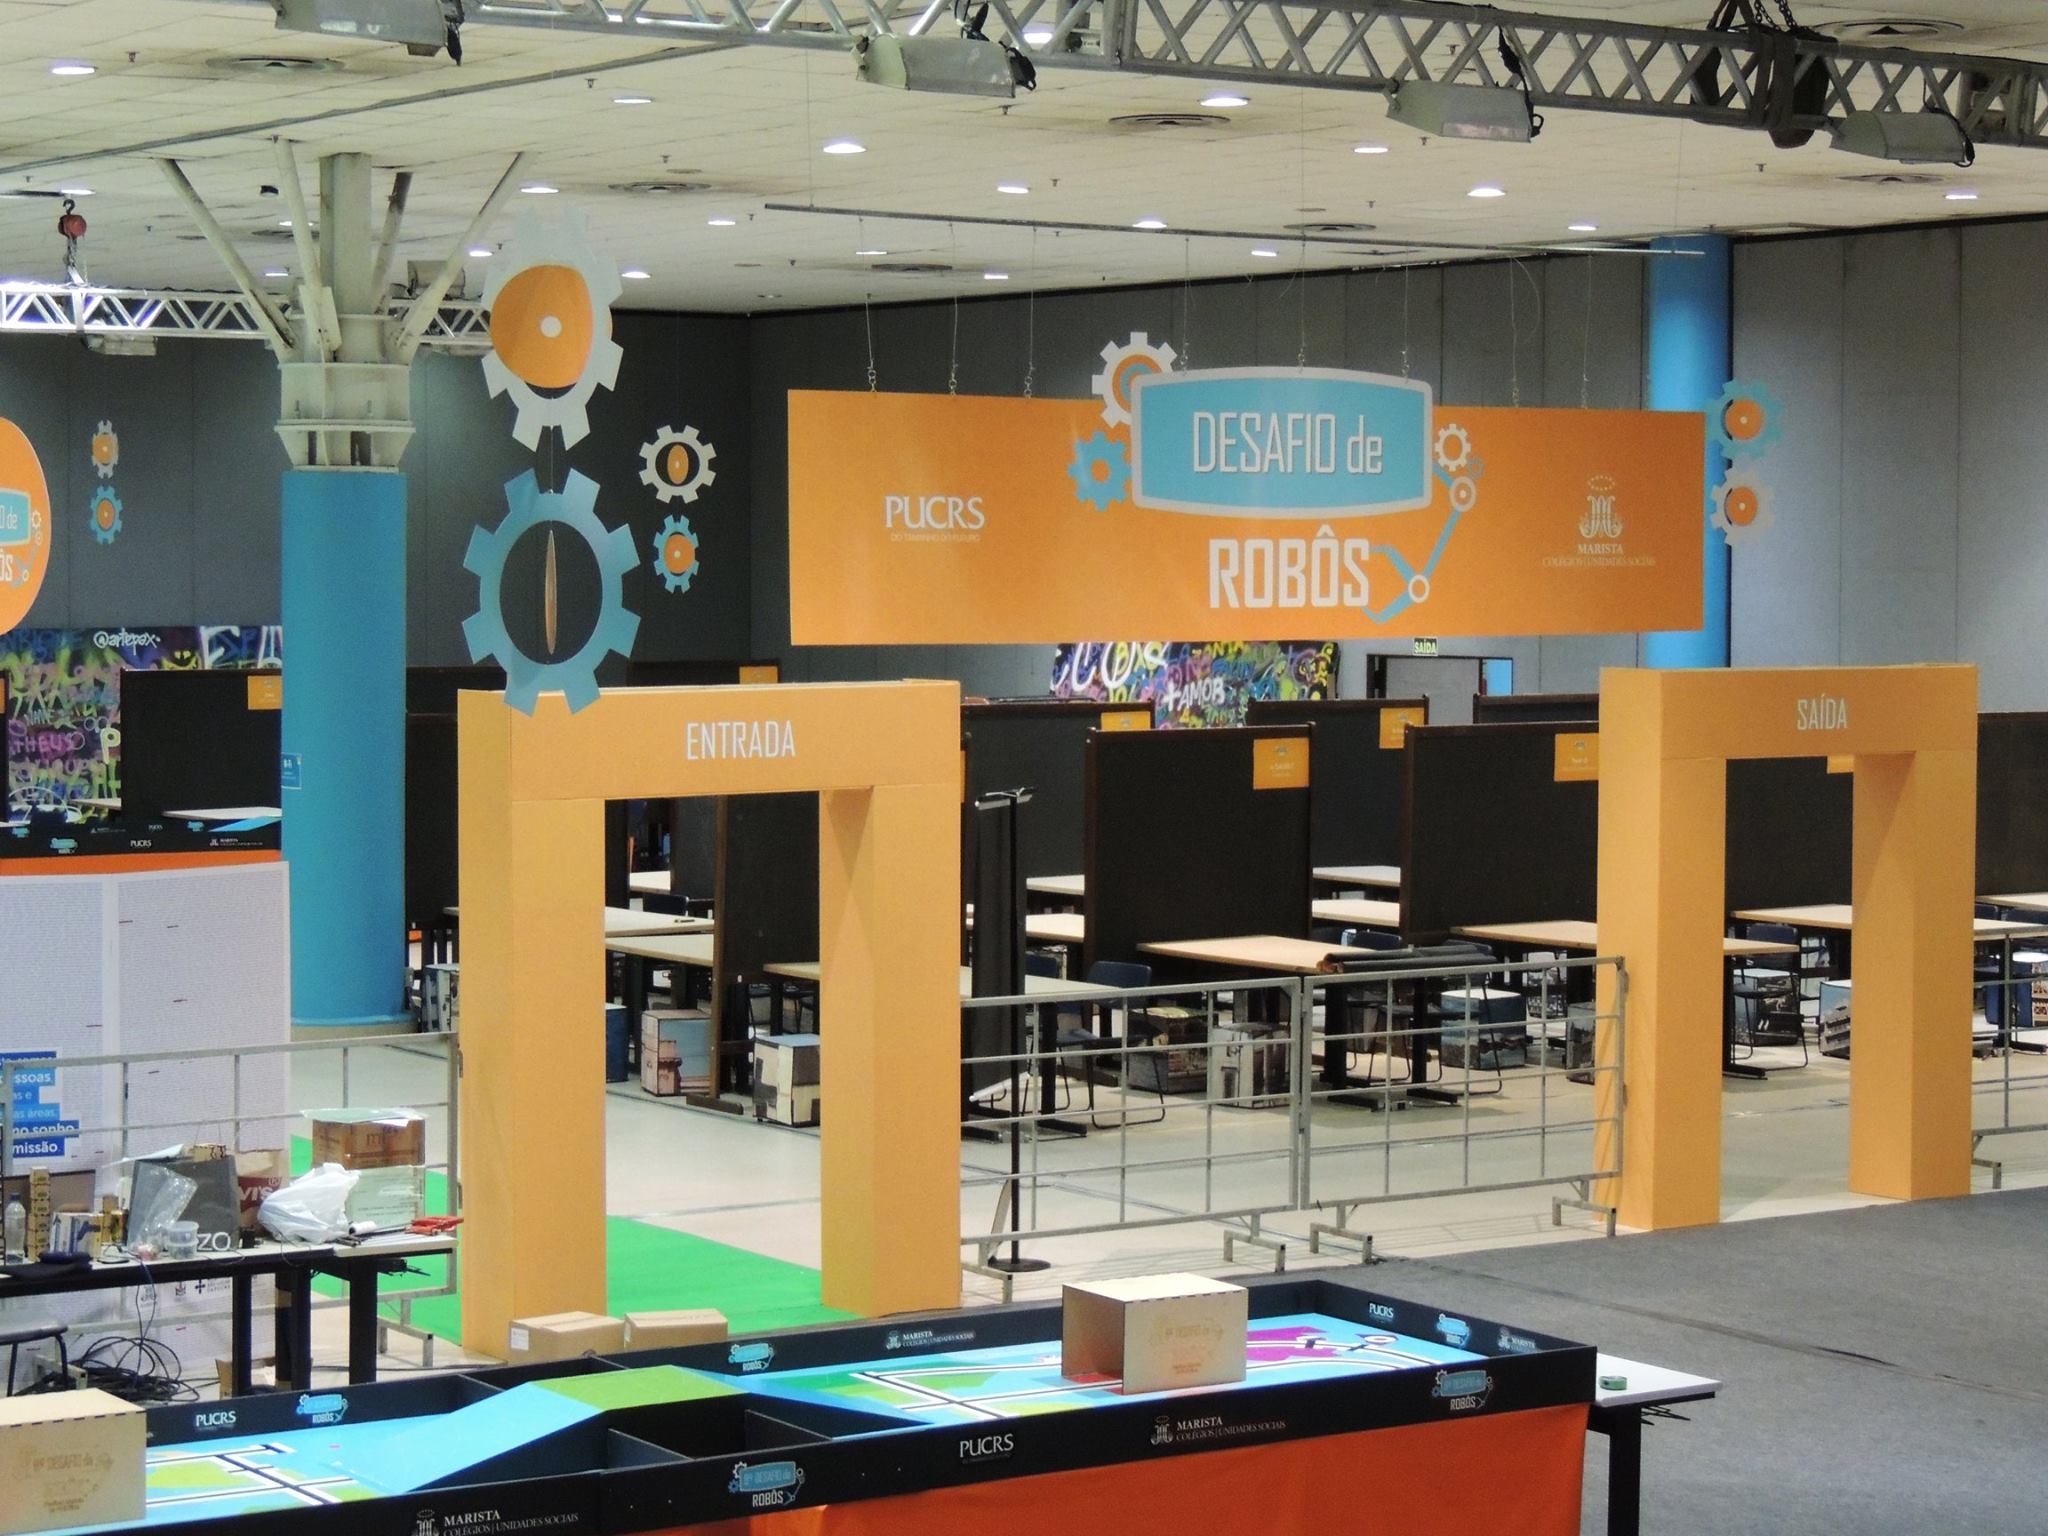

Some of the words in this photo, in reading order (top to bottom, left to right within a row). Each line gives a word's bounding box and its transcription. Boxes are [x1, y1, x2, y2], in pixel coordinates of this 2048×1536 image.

[1193, 412, 1336, 473] DESAFIO
[1346, 414, 1383, 474] de
[885, 495, 985, 529] PUCRS
[1578, 543, 1623, 554] MARISTA
[1209, 524, 1370, 608] ROBÔS
[1414, 638, 1437, 654] SAÍDA
[1797, 692, 1848, 730] SAÍDA
[687, 720, 796, 760] ENTRADA
[1369, 1303, 1394, 1318] PUCRS
[903, 1330, 933, 1341] MARISTA
[1450, 1394, 1476, 1411] ROBÔS
[195, 1411, 236, 1427] PUCRS
[1177, 1416, 1223, 1431] MARISTA
[1176, 1428, 1215, 1442] COLÉGIOS
[1219, 1423, 1257, 1438] UNIDADES
[1257, 1420, 1286, 1433] SOCIAIS
[960, 1434, 1014, 1458] PUCRS
[752, 1489, 784, 1507] ROBÔS
[443, 1523, 490, 1536] COLÉGIOS
[495, 1516, 543, 1531] UNIDADES
[544, 1512, 579, 1525] SOCIAIS
[444, 1509, 500, 1527] MARISTA
